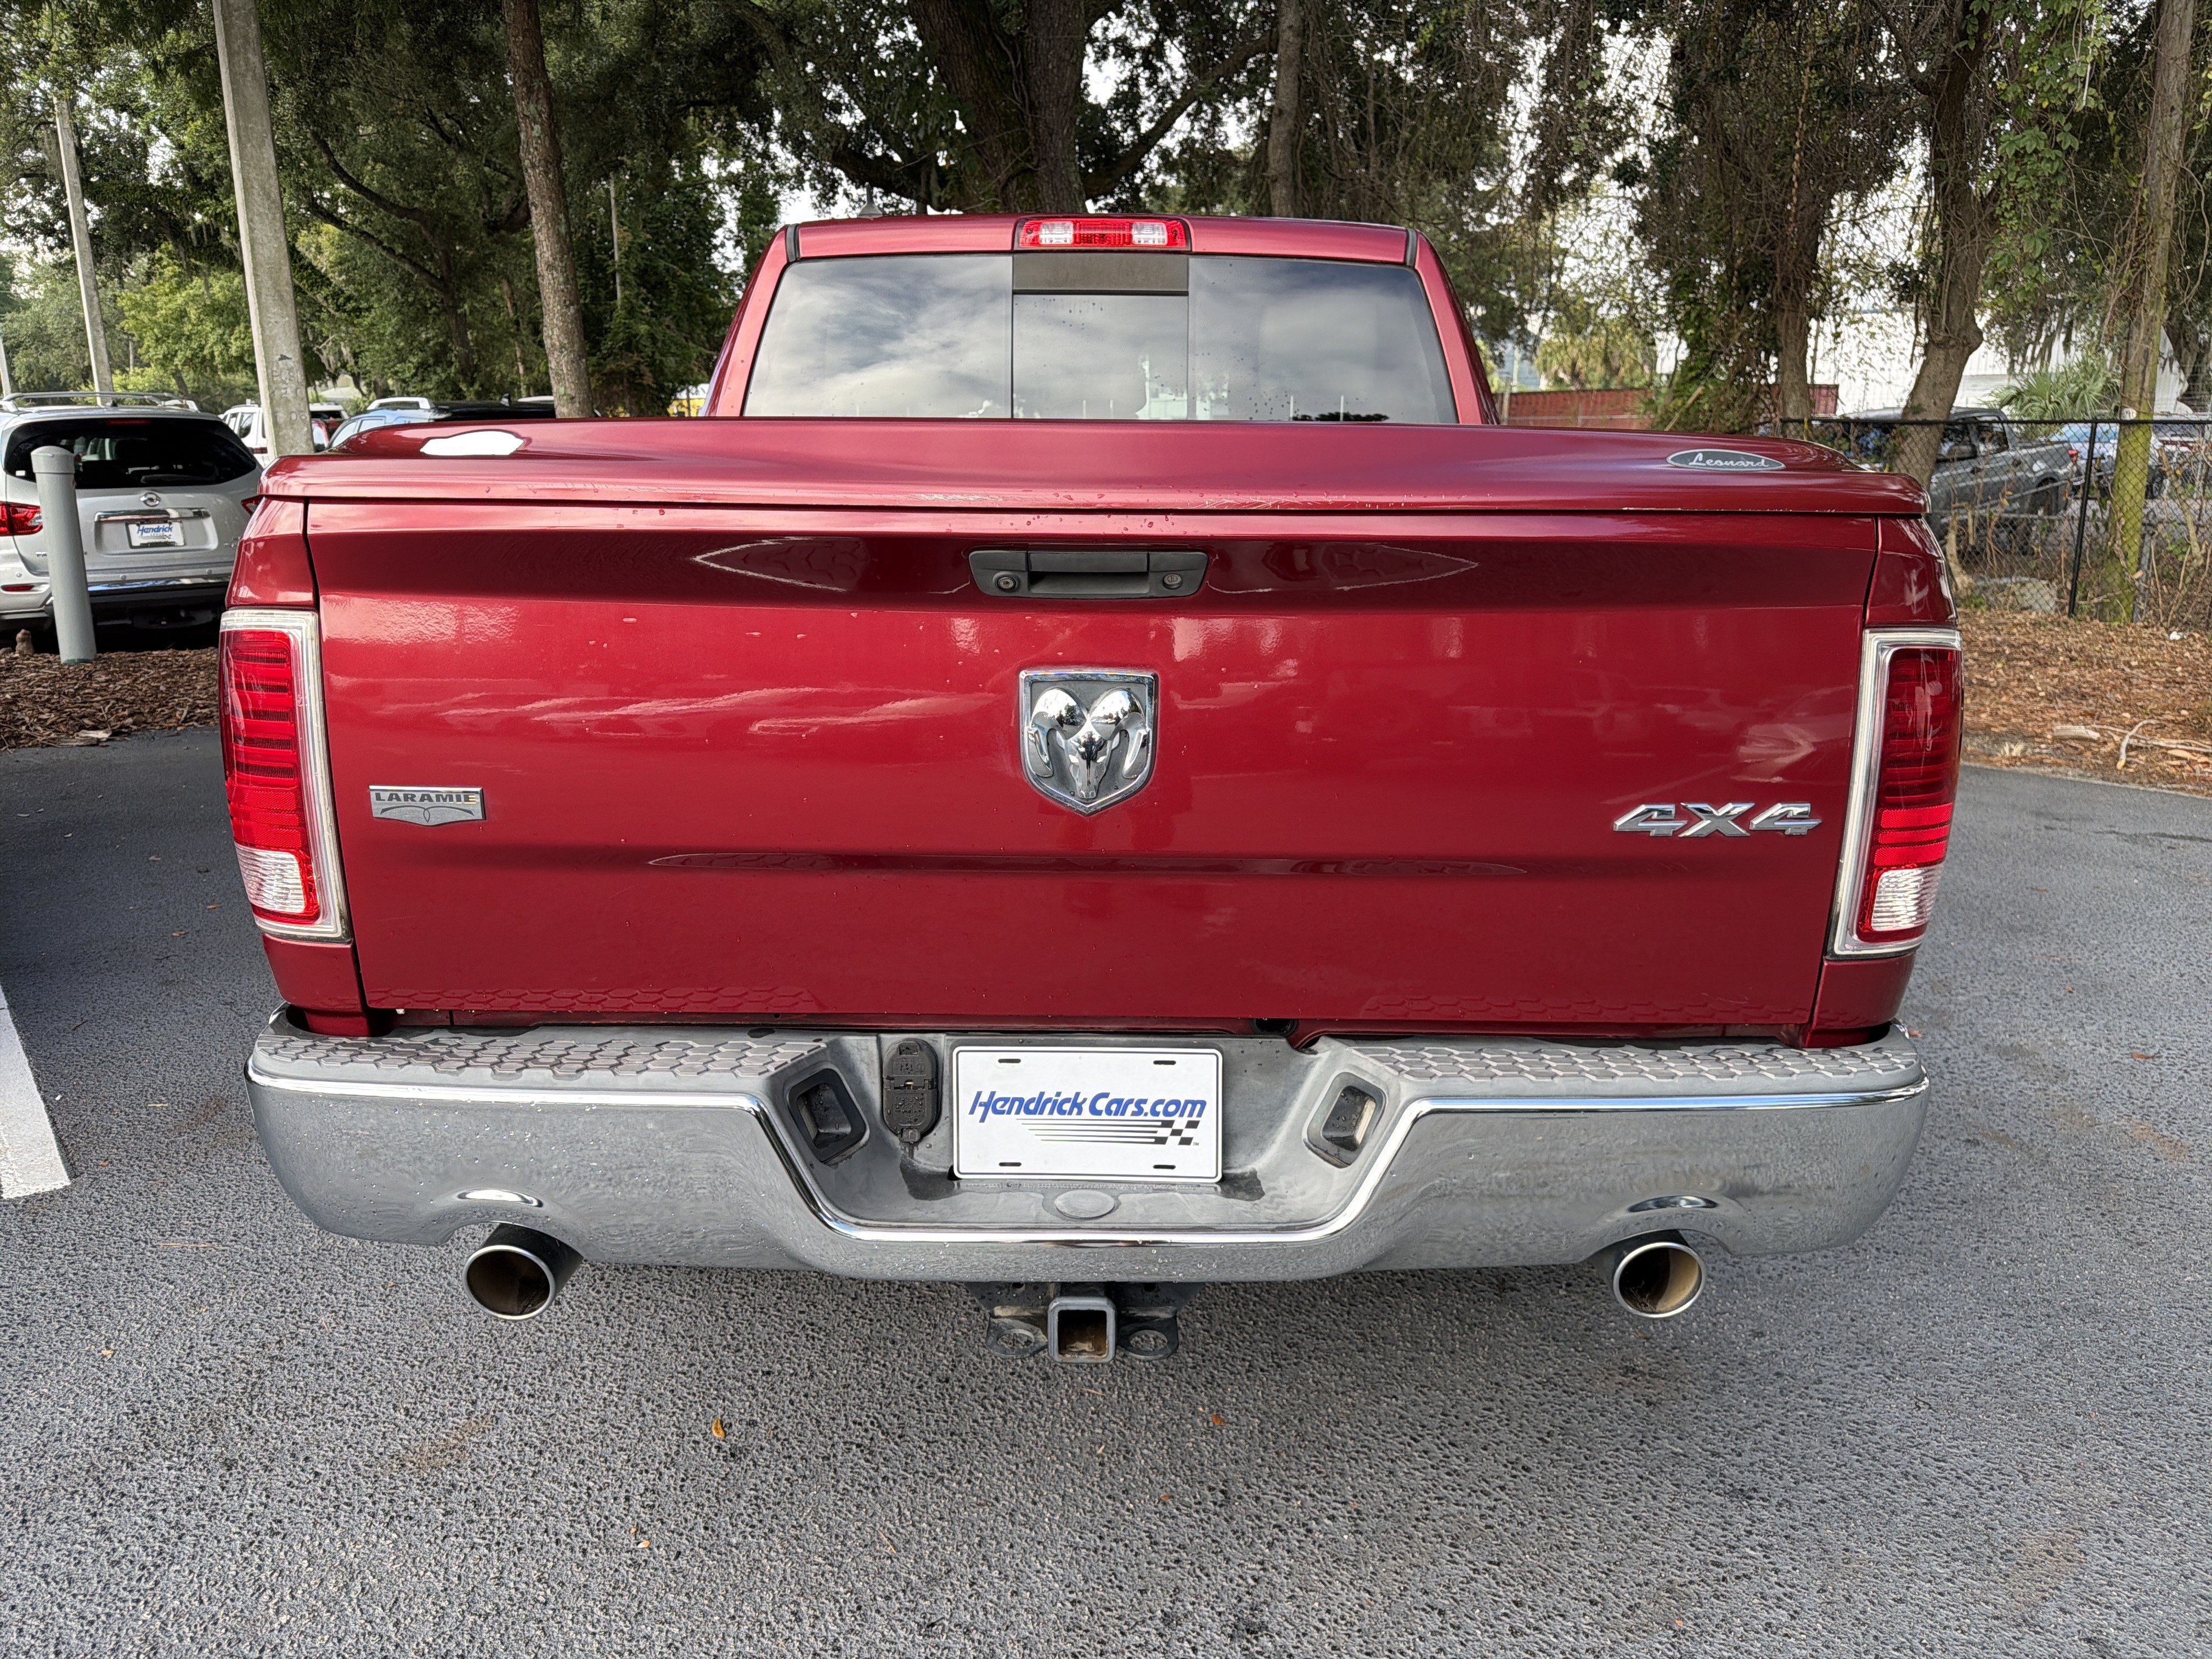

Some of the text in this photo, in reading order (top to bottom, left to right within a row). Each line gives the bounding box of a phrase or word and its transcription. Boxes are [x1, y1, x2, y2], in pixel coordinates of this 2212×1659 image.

[1688, 453, 1769, 467] Leonard
[137, 524, 173, 536] Hendrick
[374, 792, 477, 804] LARAMIE
[1612, 802, 1822, 837] 4X4
